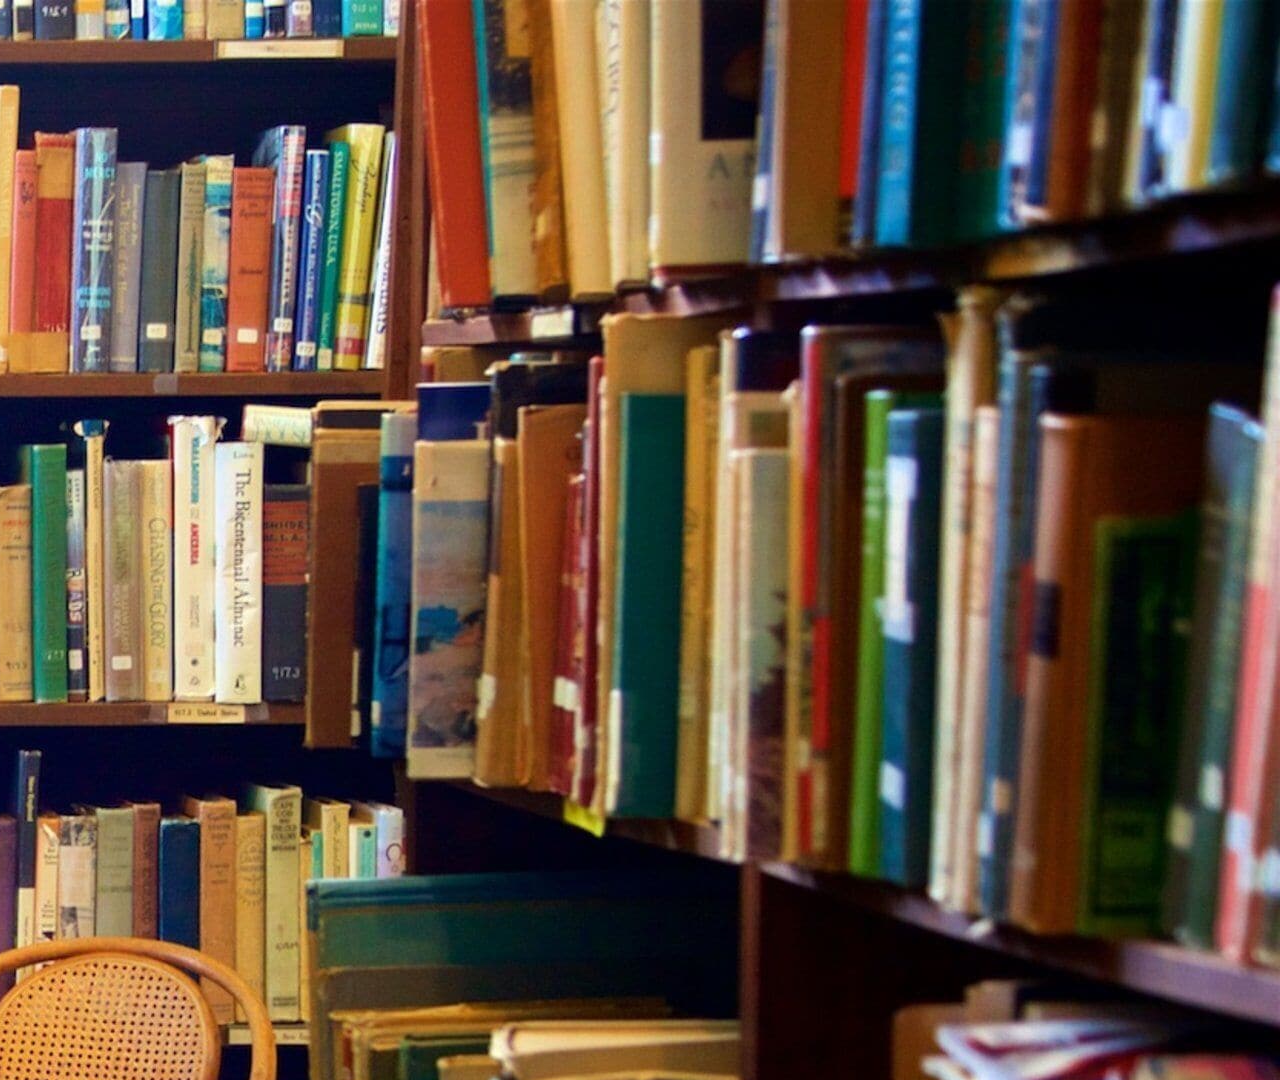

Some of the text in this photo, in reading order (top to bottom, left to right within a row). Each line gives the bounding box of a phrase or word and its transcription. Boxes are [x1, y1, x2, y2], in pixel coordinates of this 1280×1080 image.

[332, 150, 343, 186] SMALL
[328, 185, 341, 232] TOWN,
[149, 517, 169, 584] CHASING
[189, 522, 200, 565] AMERICA
[232, 467, 251, 648] The Bicentennial Almanac
[65, 567, 85, 622] ROADS
[149, 601, 168, 649] GLORY
[25, 775, 37, 823] New England
[276, 810, 294, 819] COD
